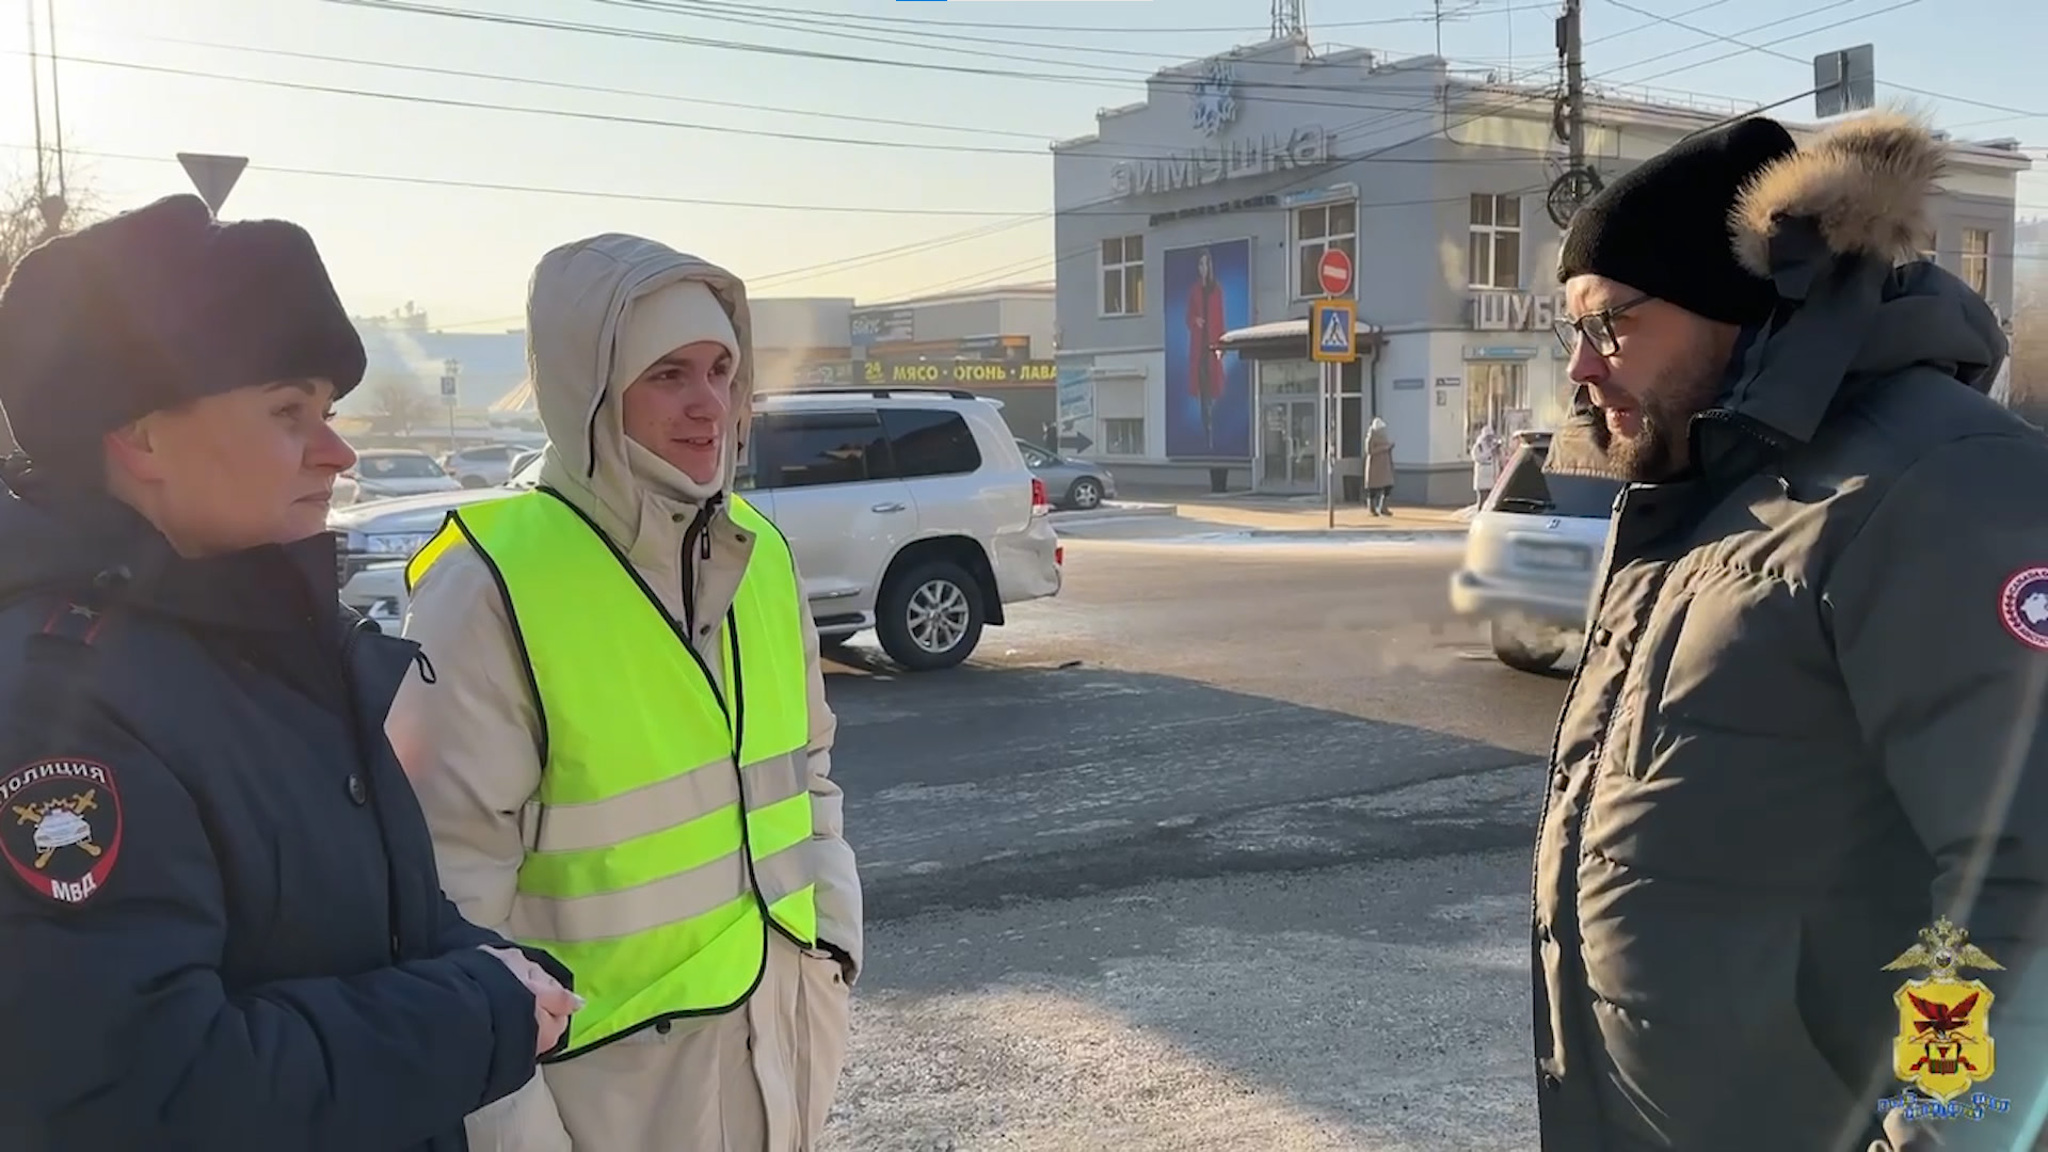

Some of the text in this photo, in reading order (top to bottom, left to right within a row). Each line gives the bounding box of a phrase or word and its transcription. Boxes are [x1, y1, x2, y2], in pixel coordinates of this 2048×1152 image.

[893, 364, 939, 381] МЯСО
[954, 364, 1006, 381] ОГОНЬ
[50, 872, 97, 902] МВД
